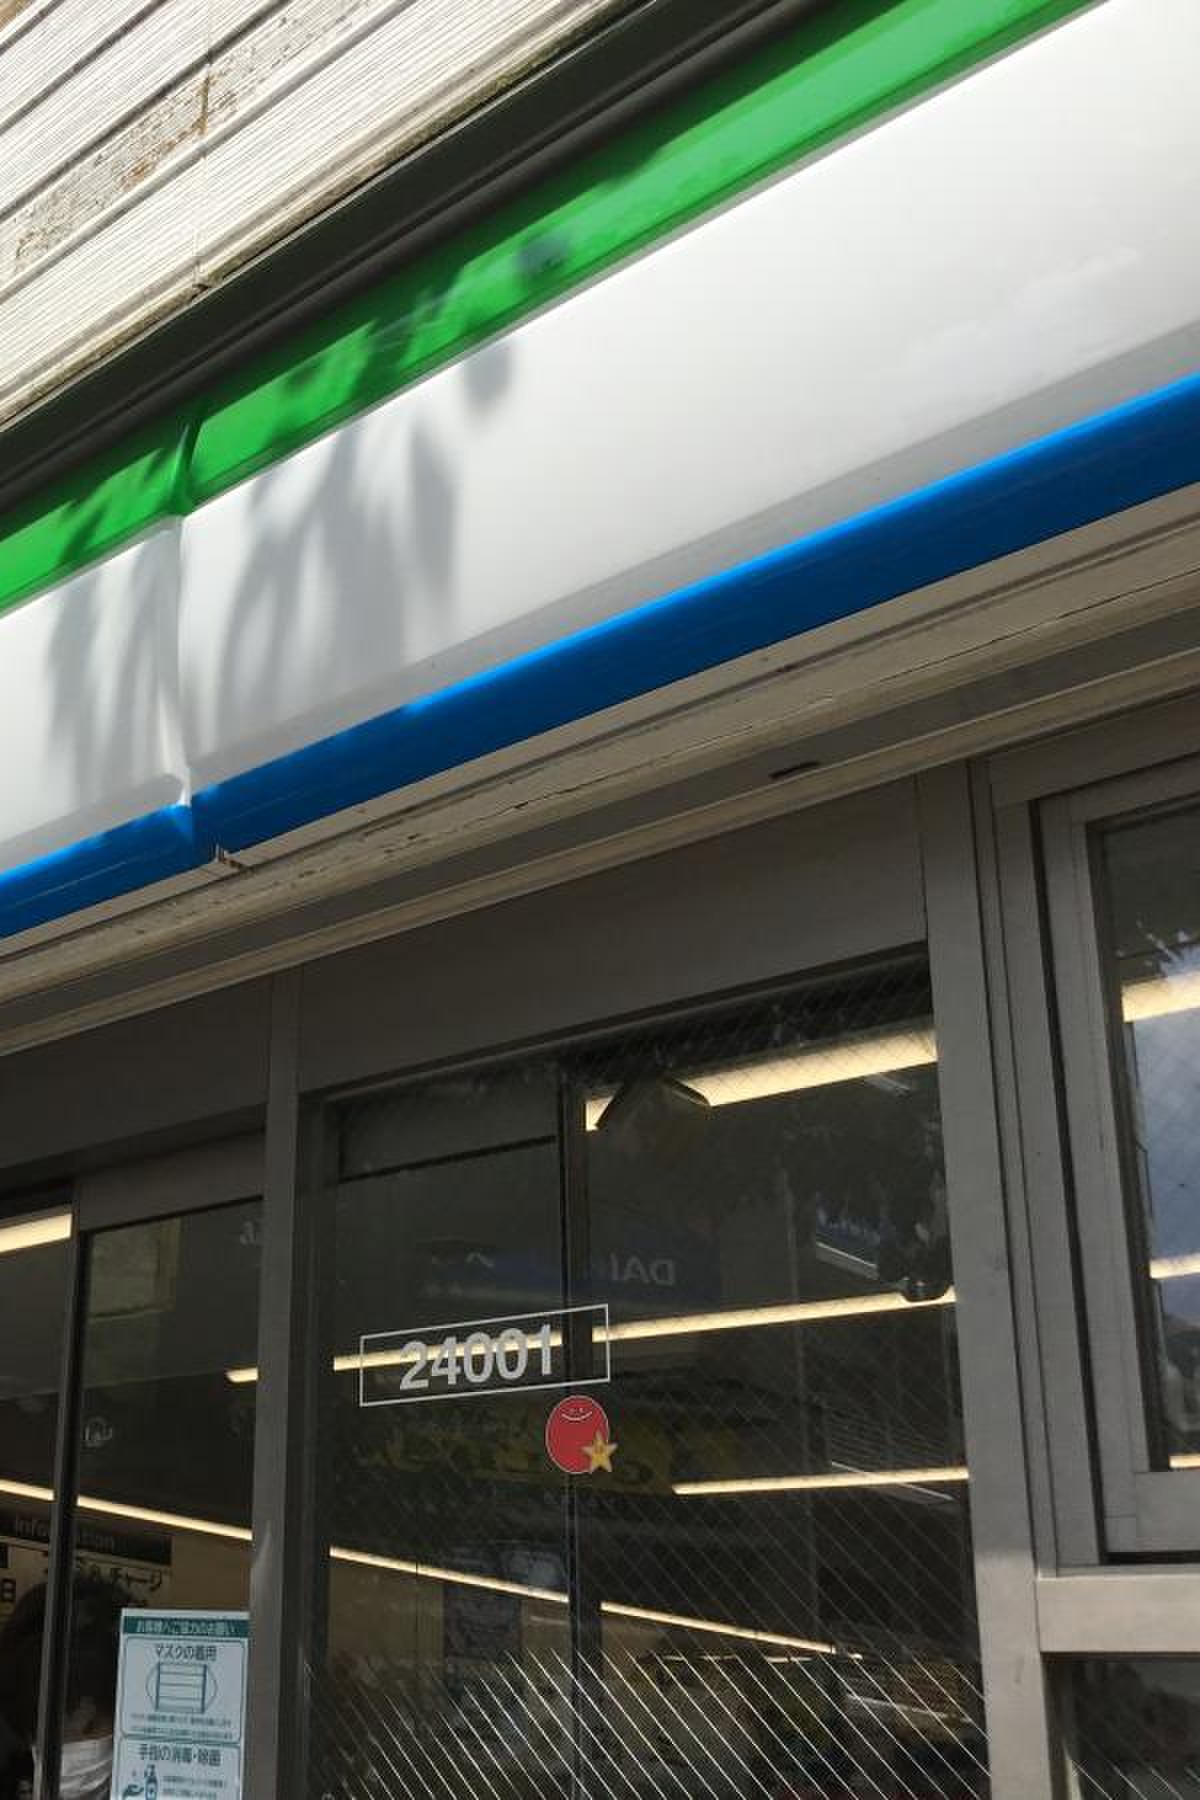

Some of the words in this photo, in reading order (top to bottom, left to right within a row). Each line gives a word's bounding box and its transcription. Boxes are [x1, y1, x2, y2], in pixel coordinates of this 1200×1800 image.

[399, 1323, 553, 1391] 24001
[154, 1643, 219, 1662] マスクの着用
